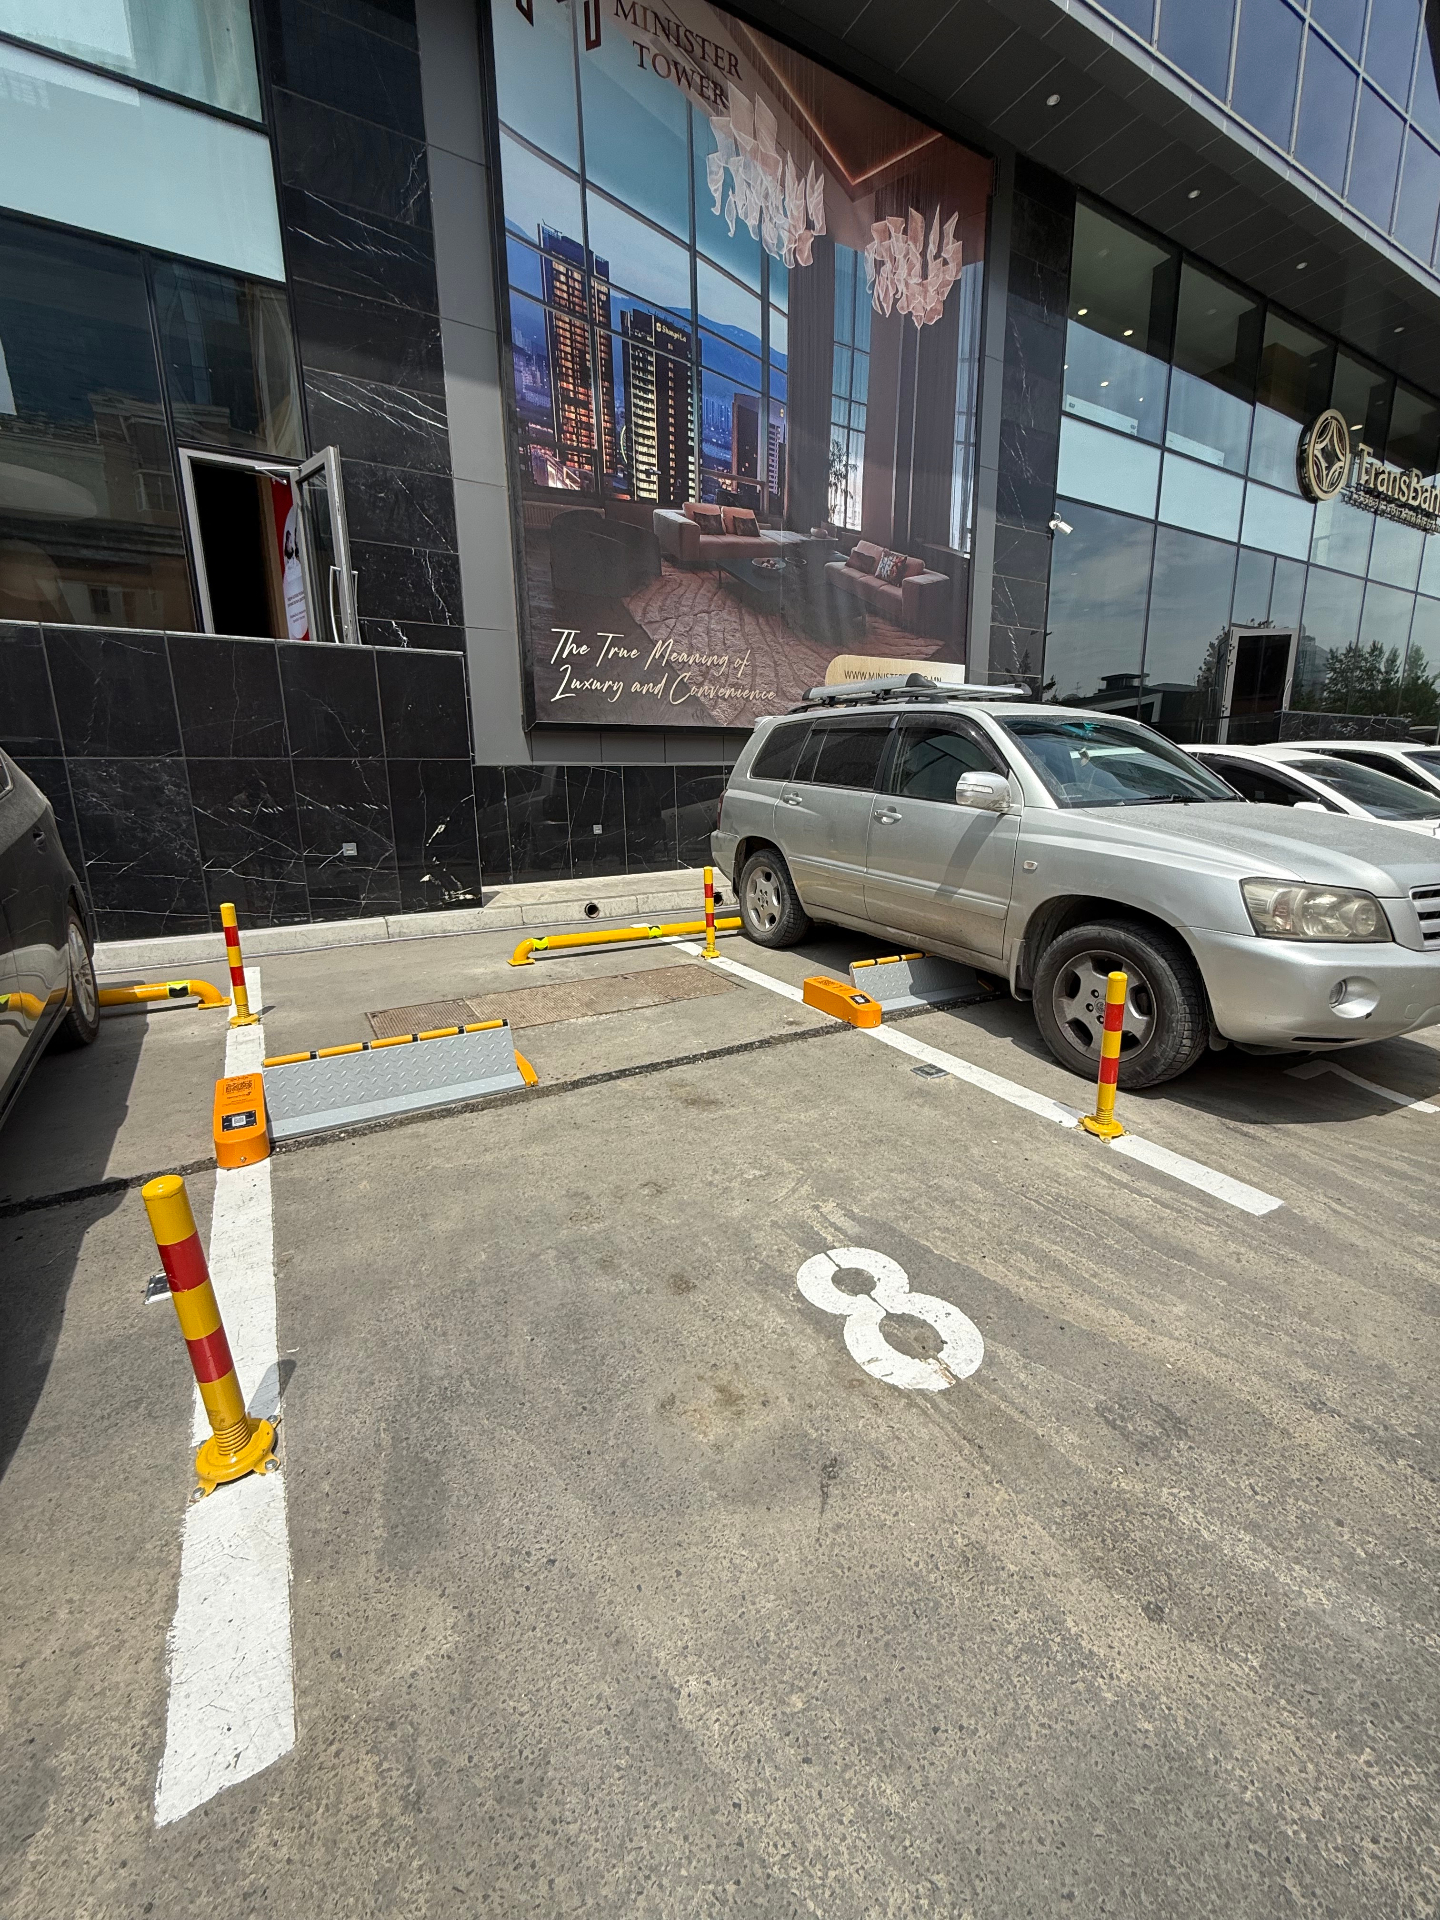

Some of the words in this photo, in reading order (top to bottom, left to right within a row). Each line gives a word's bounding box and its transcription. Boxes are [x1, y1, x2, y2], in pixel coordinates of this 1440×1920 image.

[613, 0, 743, 81] MINISTER
[632, 41, 729, 110] TOWER
[550, 628, 590, 664] The
[596, 632, 640, 667] True
[644, 638, 729, 677] Meaning
[734, 650, 751, 678] of
[550, 664, 624, 703] Luxury
[631, 672, 668, 699] and
[669, 671, 777, 705] Convenience
[797, 1246, 985, 1392] 8
